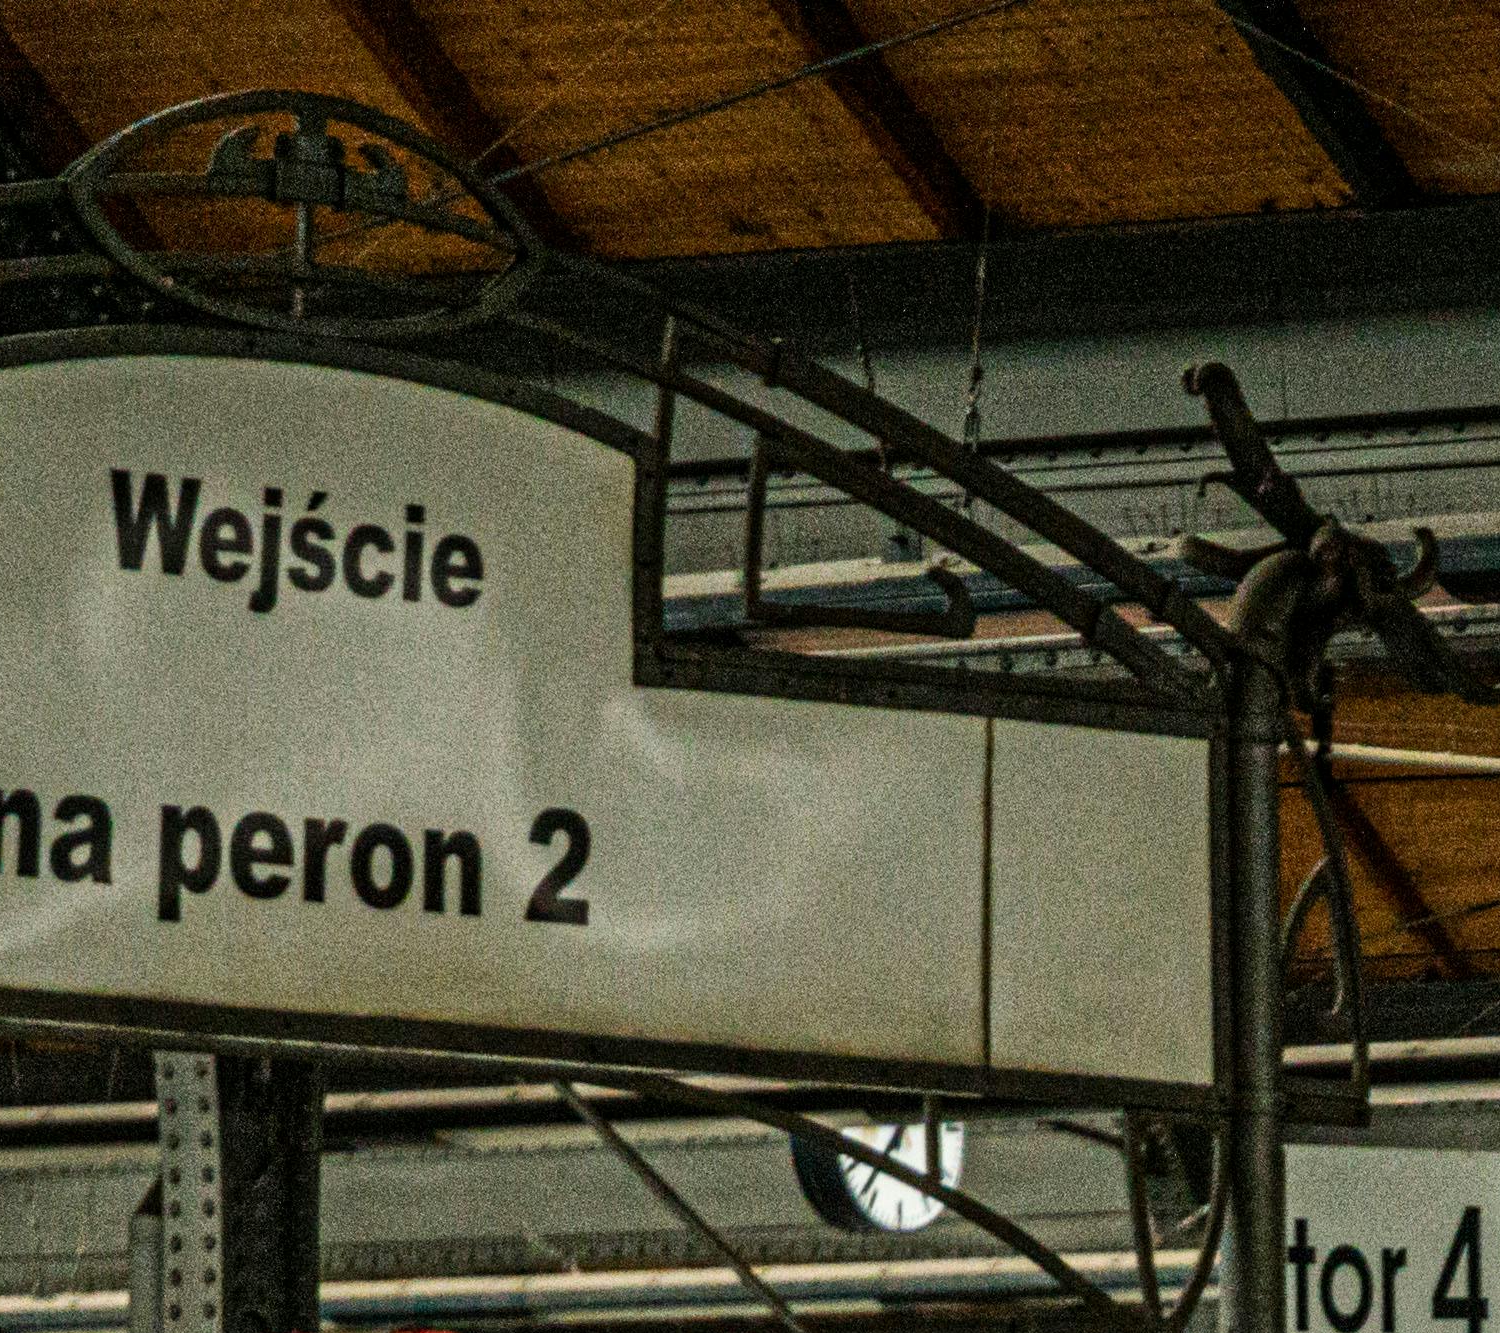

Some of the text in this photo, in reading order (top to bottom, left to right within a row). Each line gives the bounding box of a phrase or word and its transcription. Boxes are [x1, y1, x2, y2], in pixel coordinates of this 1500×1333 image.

[106, 467, 486, 615] Wejście
[156, 804, 484, 924] peron
[523, 806, 593, 926] 2
